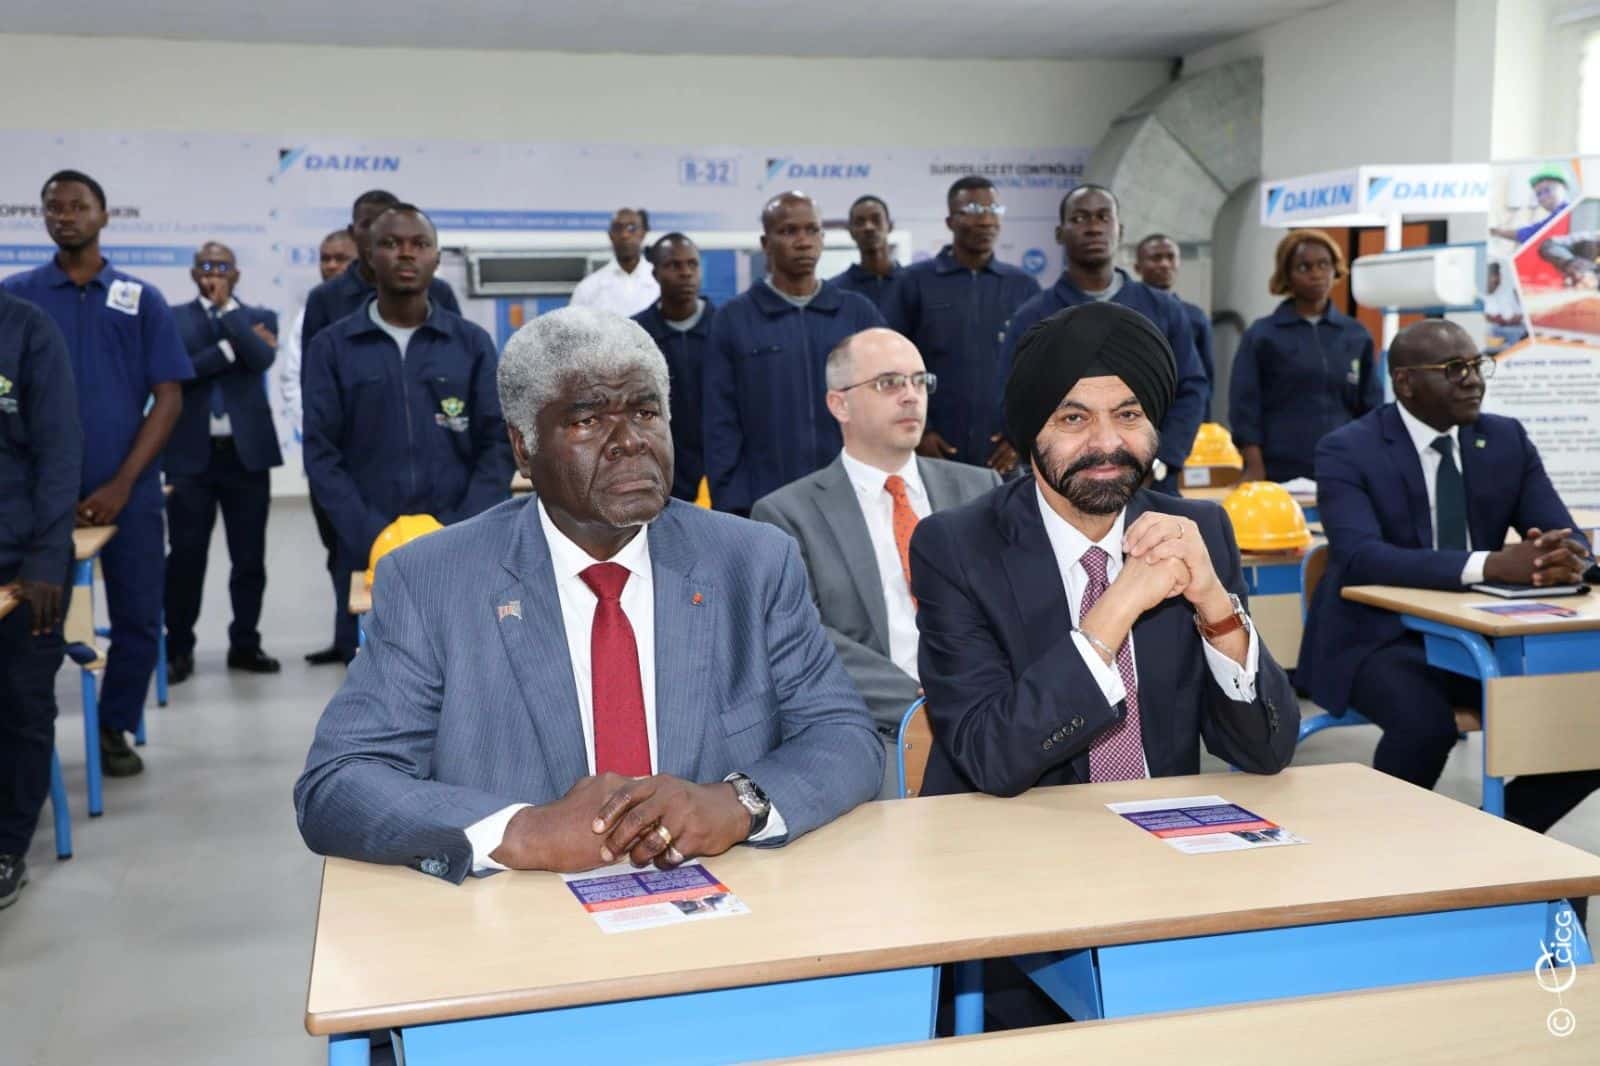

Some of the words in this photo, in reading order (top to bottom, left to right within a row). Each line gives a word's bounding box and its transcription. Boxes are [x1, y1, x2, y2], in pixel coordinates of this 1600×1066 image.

[305, 154, 400, 172] DAIKIN
[788, 163, 872, 180] DAIKIN
[1283, 183, 1354, 213] DAIKIN
[1392, 180, 1489, 200] DAIKIN
